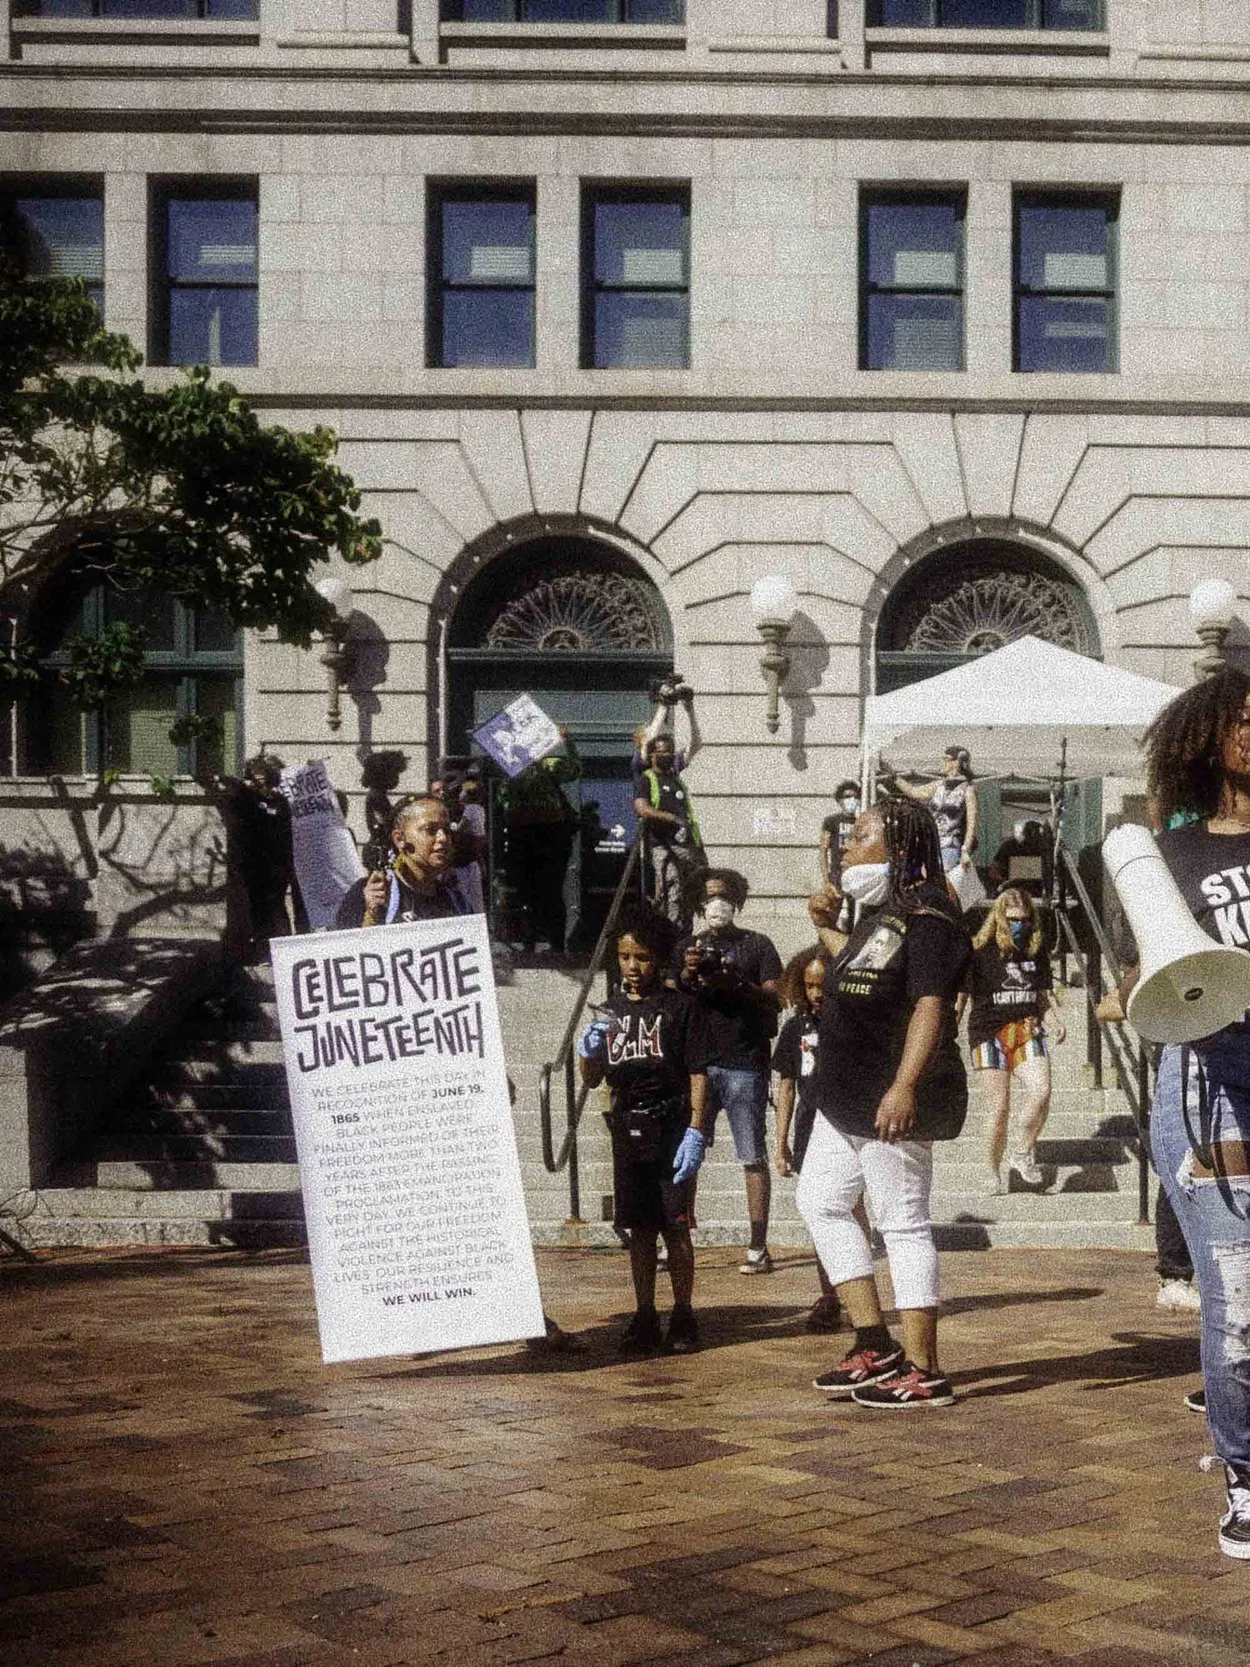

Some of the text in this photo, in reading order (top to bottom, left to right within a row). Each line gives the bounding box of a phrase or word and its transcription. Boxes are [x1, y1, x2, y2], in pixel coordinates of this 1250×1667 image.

[292, 938, 480, 1019] CELEBRATE
[293, 1001, 483, 1072] JUNETEENTH
[431, 1085, 465, 1098] JUNE
[331, 1112, 360, 1124] 1865
[382, 1286, 476, 1308] WE WILL WIN.
